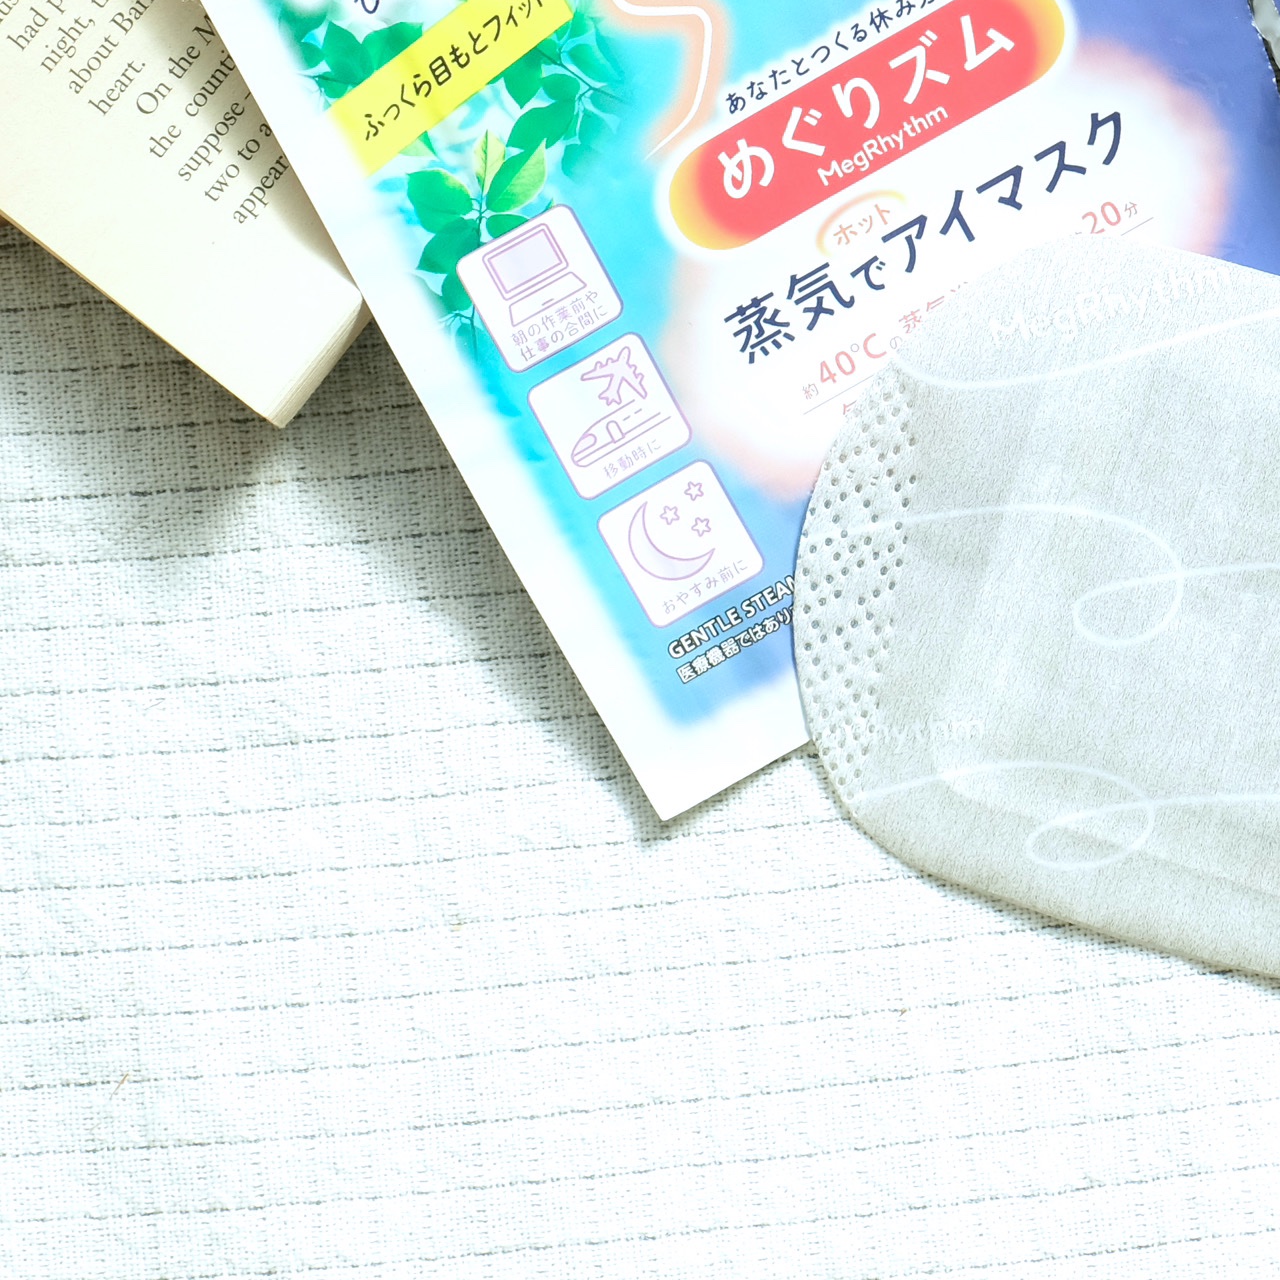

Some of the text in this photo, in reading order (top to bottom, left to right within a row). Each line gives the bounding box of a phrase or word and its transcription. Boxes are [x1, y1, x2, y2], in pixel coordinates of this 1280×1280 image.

[87, 60, 146, 116] heart.
[717, 13, 1016, 199] めぐりズム
[816, 104, 949, 187] MegRhythm
[724, 111, 1122, 364] 蒸気でアイマスク
[832, 202, 894, 248] ホット
[602, 439, 663, 480] 移動時に
[662, 558, 748, 615] おやすみ前に
[668, 607, 743, 659] GENTLE
[676, 604, 795, 685] 医療機器ではあり
